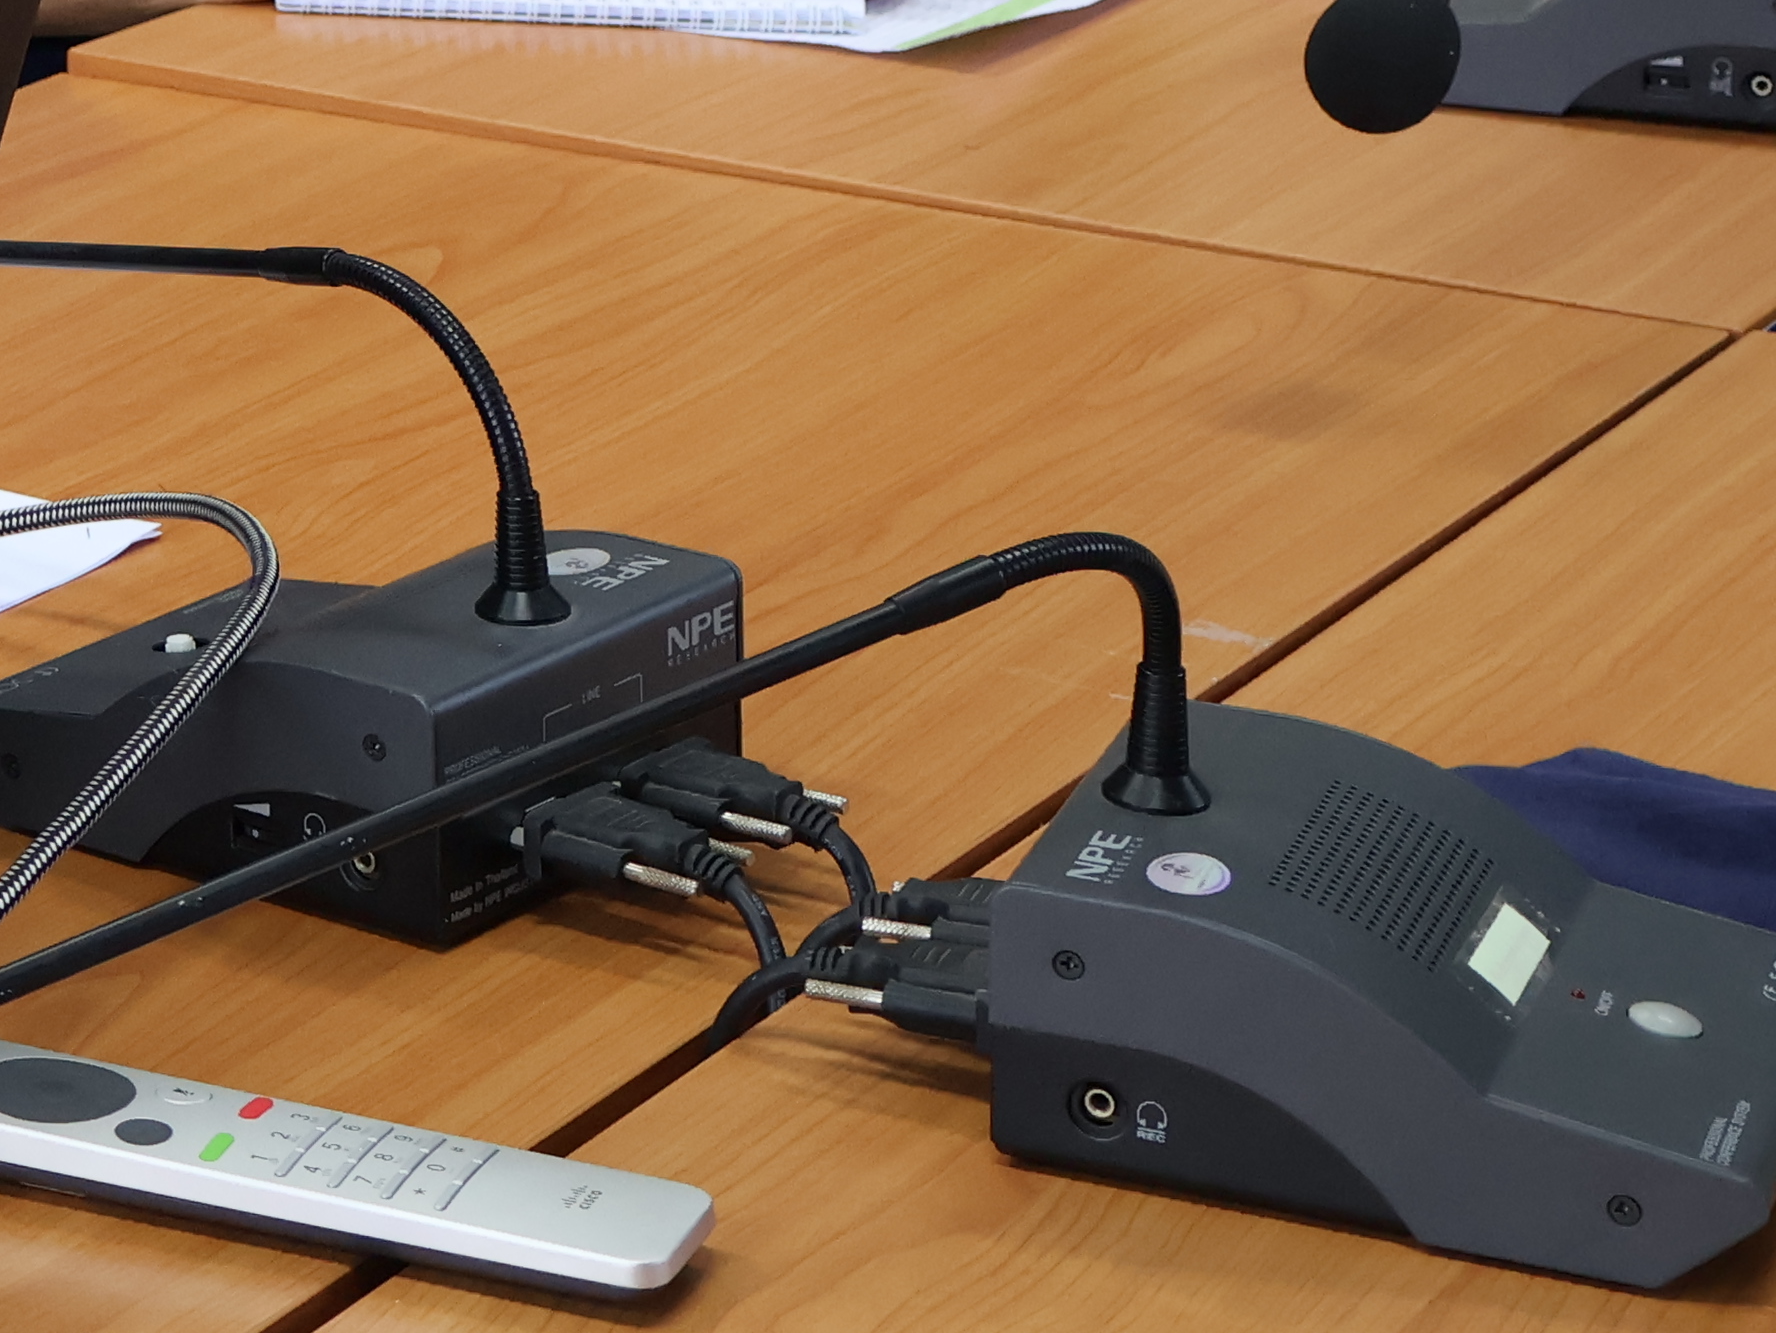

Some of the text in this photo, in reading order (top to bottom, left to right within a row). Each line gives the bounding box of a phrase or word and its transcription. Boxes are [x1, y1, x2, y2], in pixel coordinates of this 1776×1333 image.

[666, 600, 736, 657] NPE
[1065, 829, 1133, 884] NPE
[290, 1111, 312, 1122] 3
[342, 1123, 362, 1132] 6
[270, 1130, 291, 1141] 2
[393, 1133, 414, 1143] 9
[321, 1142, 342, 1152] 5
[250, 1153, 270, 1162] 1
[373, 1152, 394, 1163] 8
[303, 1163, 322, 1175] 4
[425, 1163, 447, 1173] 0
[352, 1175, 373, 1186] 7
